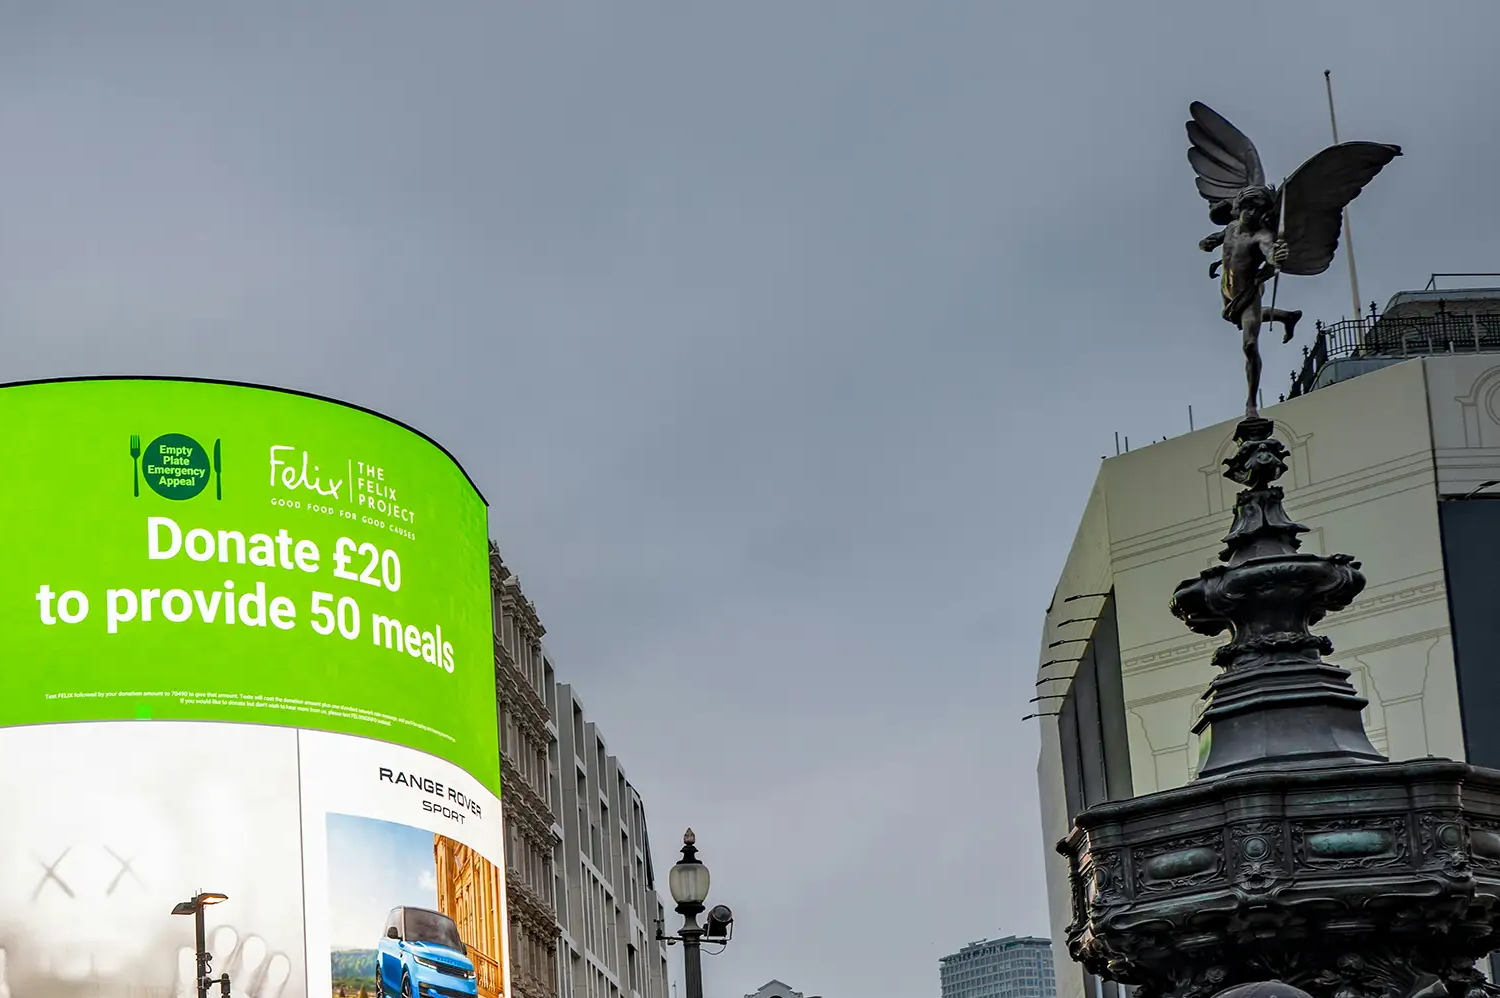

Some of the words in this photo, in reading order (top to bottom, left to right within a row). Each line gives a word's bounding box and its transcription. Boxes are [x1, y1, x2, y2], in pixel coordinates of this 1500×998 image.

[159, 444, 193, 457] Empty
[163, 455, 190, 466] Plate
[147, 464, 206, 478] Emergency
[159, 475, 195, 487] Appeal
[269, 445, 343, 500] Felix
[357, 461, 385, 482] THE
[358, 478, 397, 501] FELIX
[270, 497, 301, 509] GOOD
[307, 503, 334, 515] FOOD
[339, 509, 357, 521] FOR
[361, 515, 386, 529] GOOD
[389, 524, 416, 541] CAUSES
[359, 493, 415, 524] PROJECT
[147, 516, 321, 573] Donate
[333, 536, 402, 593] £20
[35, 584, 90, 626] to
[106, 579, 297, 634] provide
[310, 591, 361, 641] 50
[372, 612, 455, 674] meals
[379, 767, 444, 798] RANGE
[447, 787, 482, 820] ROVER
[422, 800, 466, 825] SPORT
